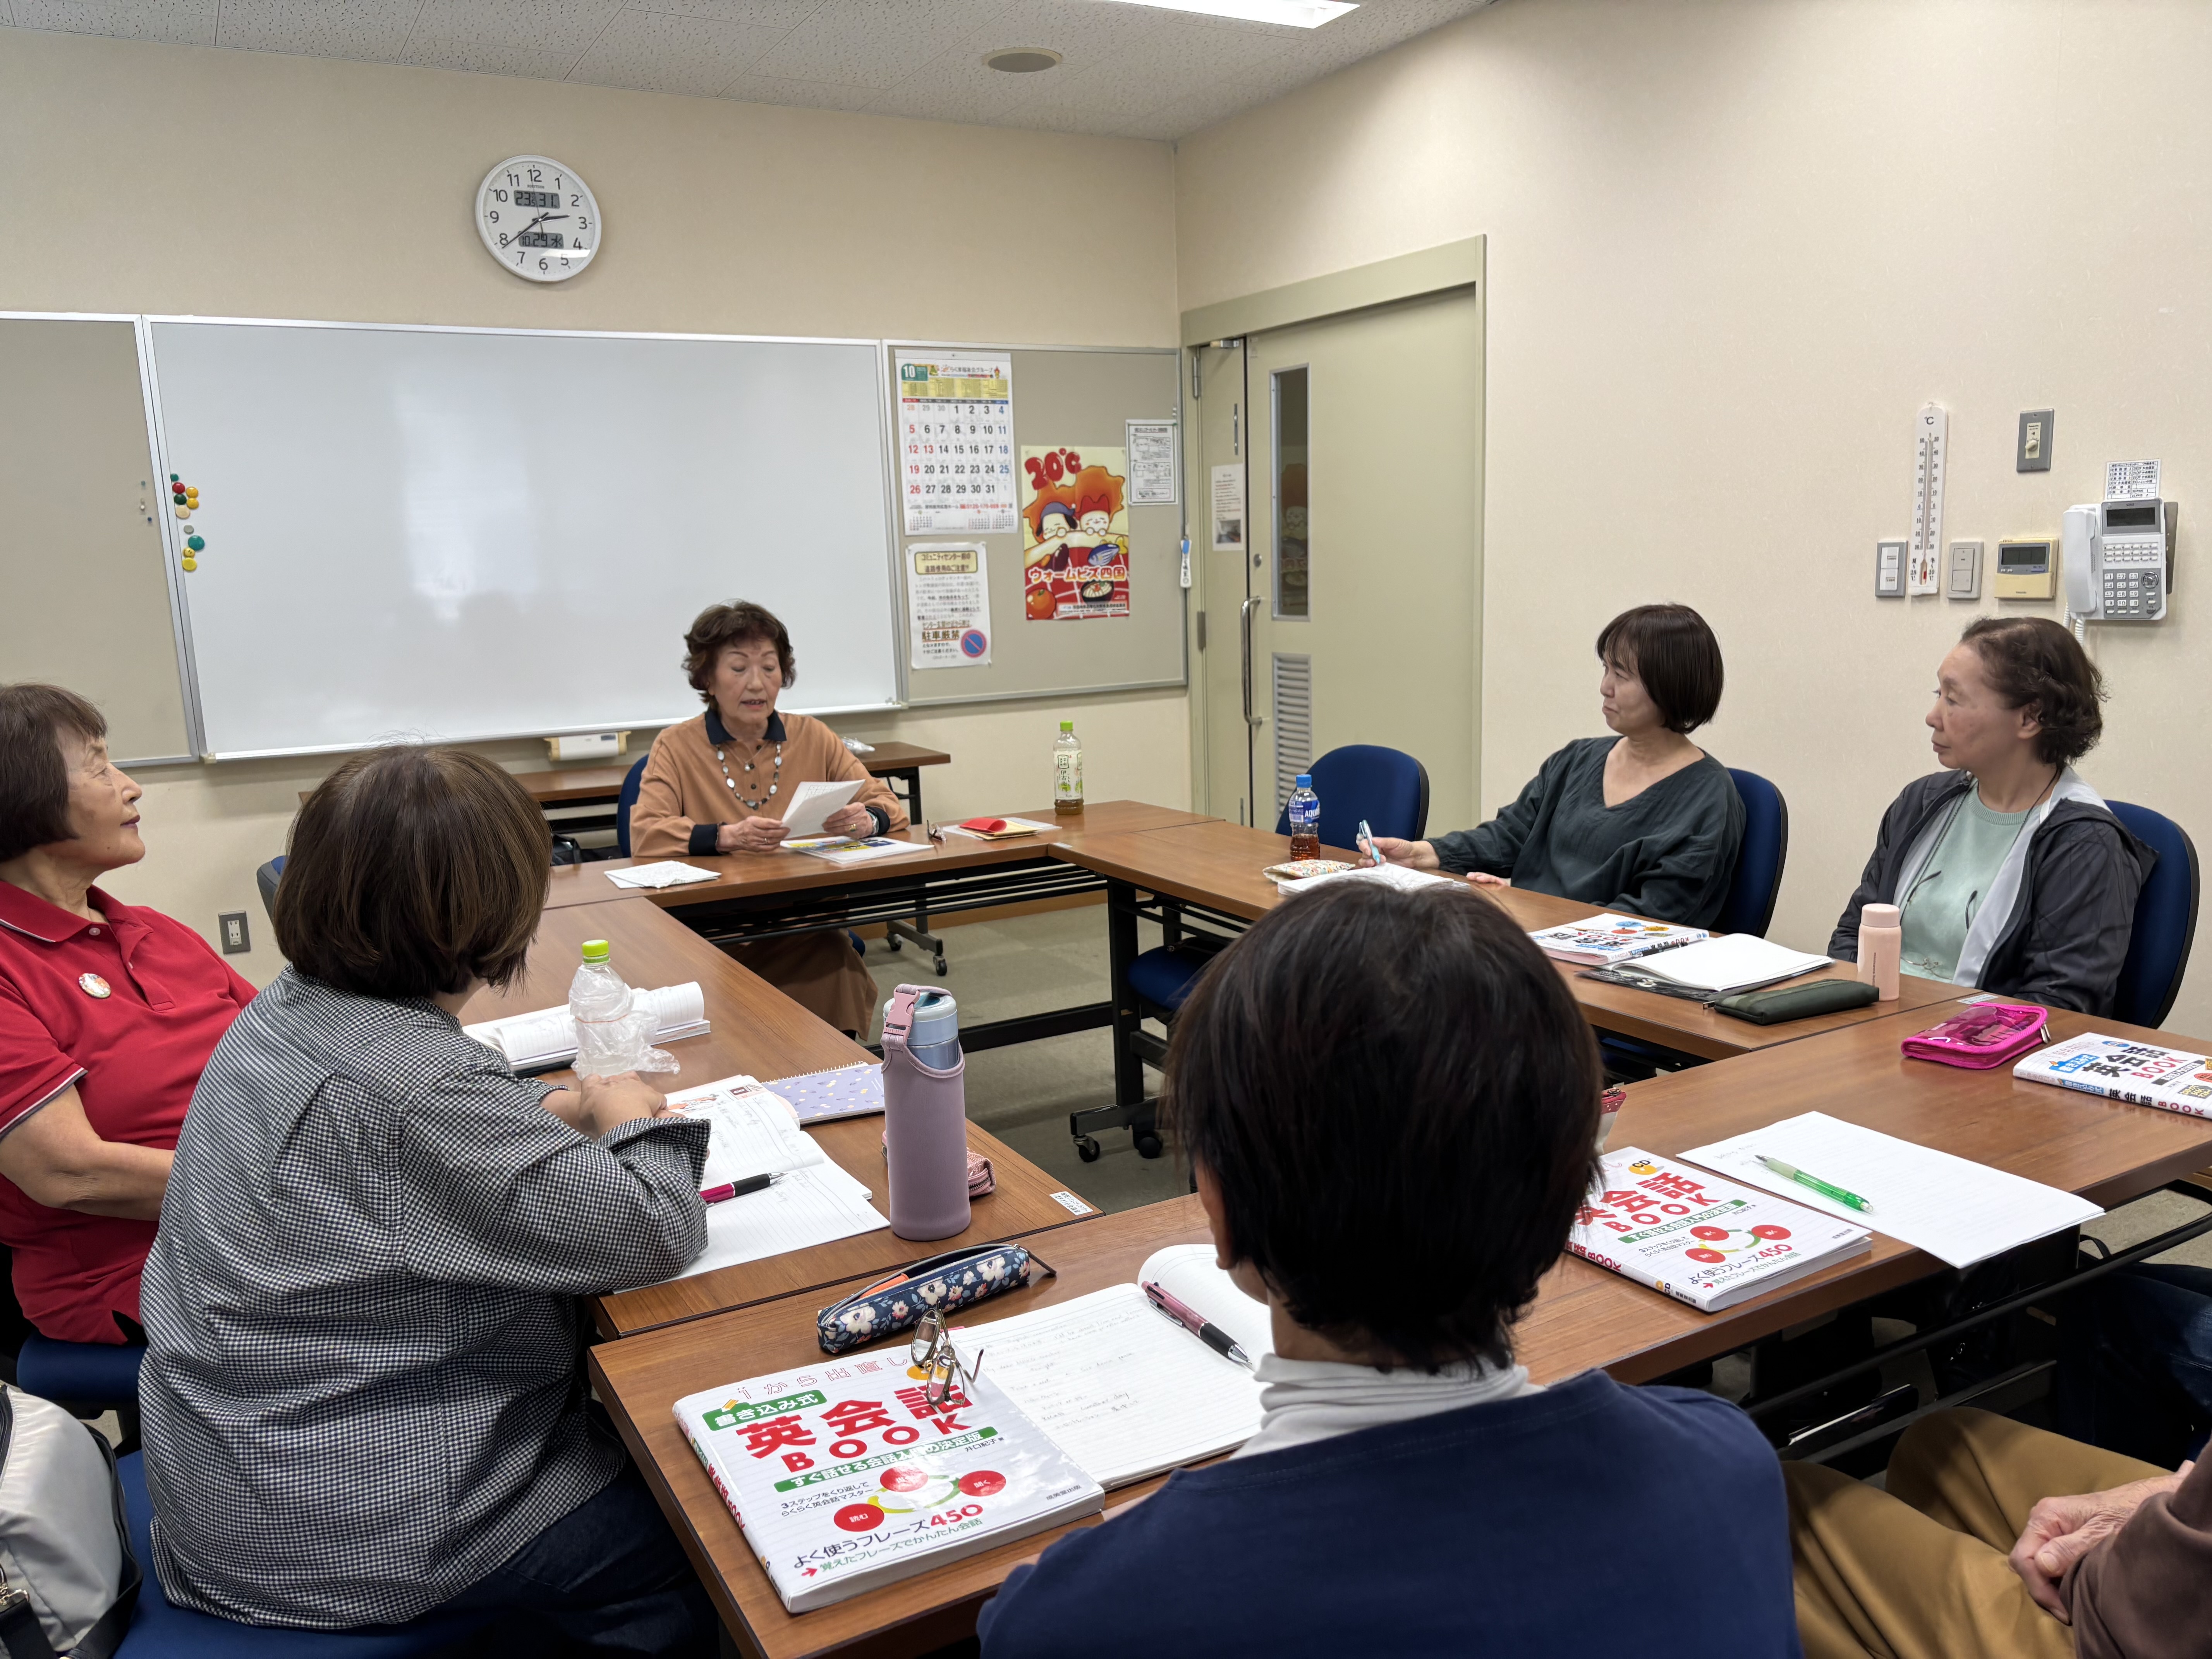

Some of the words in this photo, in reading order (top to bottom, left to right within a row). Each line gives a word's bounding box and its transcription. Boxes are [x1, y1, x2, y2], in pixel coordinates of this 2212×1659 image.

[507, 173, 520, 187] 11
[527, 169, 542, 182] 12
[555, 177, 561, 190] 1
[493, 189, 508, 202] 10
[571, 194, 580, 207] 2
[489, 211, 499, 223] 9
[579, 216, 587, 229] 3
[500, 233, 509, 246] 8
[573, 237, 582, 250] 4
[517, 251, 526, 264] 7
[539, 258, 548, 270] 6
[560, 254, 569, 266] 5
[903, 365, 915, 378] 10
[955, 405, 959, 414] 1
[969, 405, 974, 414] 2
[984, 405, 989, 414] 3
[998, 406, 1004, 415] 4
[909, 425, 915, 434] 5
[924, 425, 930, 434] 6
[939, 425, 945, 434] 7
[955, 425, 960, 434] 8
[970, 425, 975, 434] 9
[984, 426, 993, 434] 10
[998, 426, 1006, 434] 11
[908, 445, 919, 453] 12
[924, 445, 934, 454] 13
[939, 445, 949, 454] 14
[954, 445, 964, 454] 15
[969, 445, 979, 454] 16
[984, 445, 994, 454] 17
[999, 445, 1008, 454] 18
[909, 465, 920, 474] 19
[924, 465, 935, 474] 20
[939, 465, 949, 474] 21
[955, 465, 965, 474] 22
[970, 465, 980, 474] 23
[985, 465, 995, 474] 24
[999, 465, 1010, 474] 25
[910, 485, 921, 494] 26
[926, 484, 936, 493] 27
[941, 484, 951, 493] 28
[956, 484, 966, 493] 29
[970, 484, 981, 493] 30
[985, 484, 995, 493] 31
[1029, 566, 1126, 583] ウォームビズ四国
[2081, 1046, 2170, 1078] 英会話
[2131, 1057, 2188, 1079] BOOK
[2158, 1101, 2204, 1116] BOOK
[1632, 1159, 1651, 1168] CD
[1602, 1192, 1723, 1233] BOOK
[1588, 1251, 1622, 1272] BOOK
[714, 1393, 819, 1427] 書き込み式
[735, 1384, 974, 1460] 英会話
[780, 1413, 973, 1474] BOOK
[973, 1479, 991, 1488] 聞く
[781, 1481, 870, 1509] 3ステップをくり返して
[781, 1488, 874, 1517] らくらく英会話マスター
[849, 1513, 869, 1523] 読む
[819, 1517, 984, 1573] 覚えたフレーズでかんたん会話
